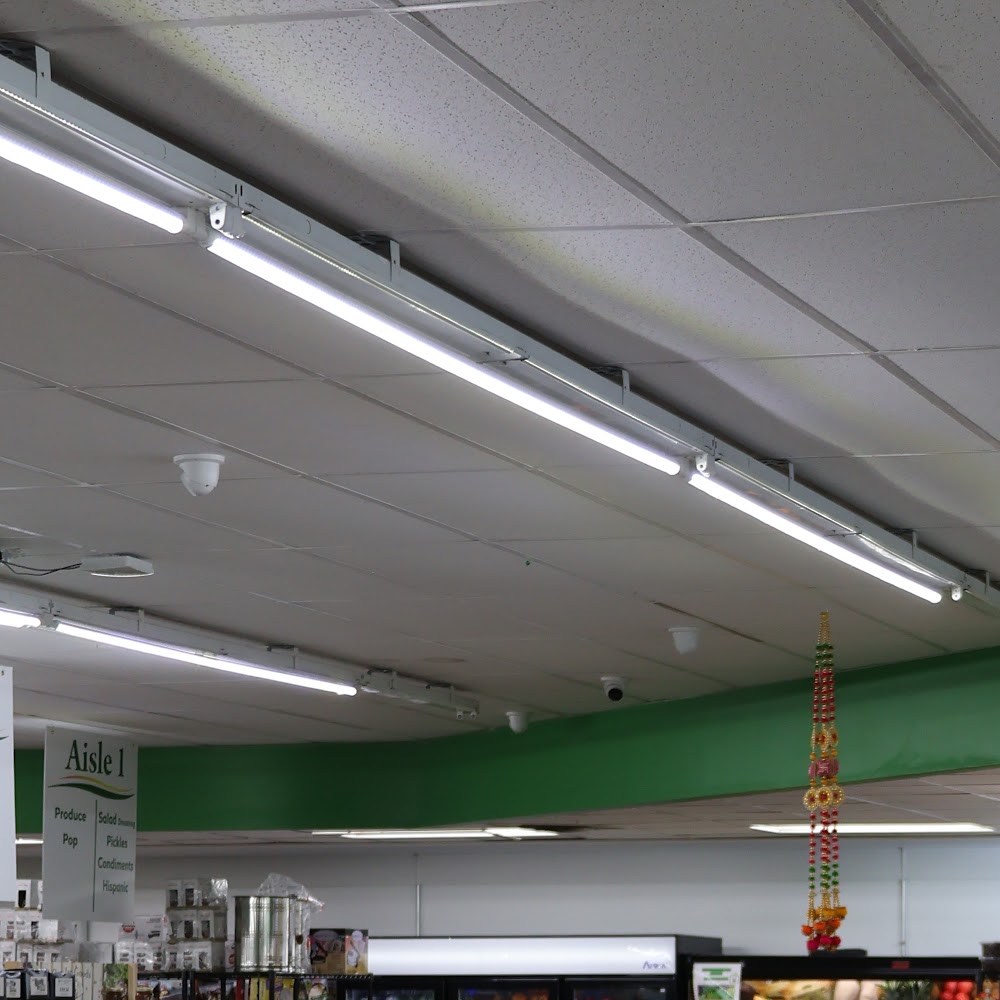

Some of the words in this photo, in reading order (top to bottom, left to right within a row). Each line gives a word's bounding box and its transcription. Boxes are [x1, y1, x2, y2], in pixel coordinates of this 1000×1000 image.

[65, 739, 112, 776] Aisle
[118, 748, 125, 777] 1
[54, 807, 87, 822] Produce
[98, 811, 118, 825] Salad
[63, 833, 78, 849] Pop
[106, 835, 128, 849] Pickles
[97, 856, 134, 872] Condiments
[102, 879, 129, 895] Hispanic
